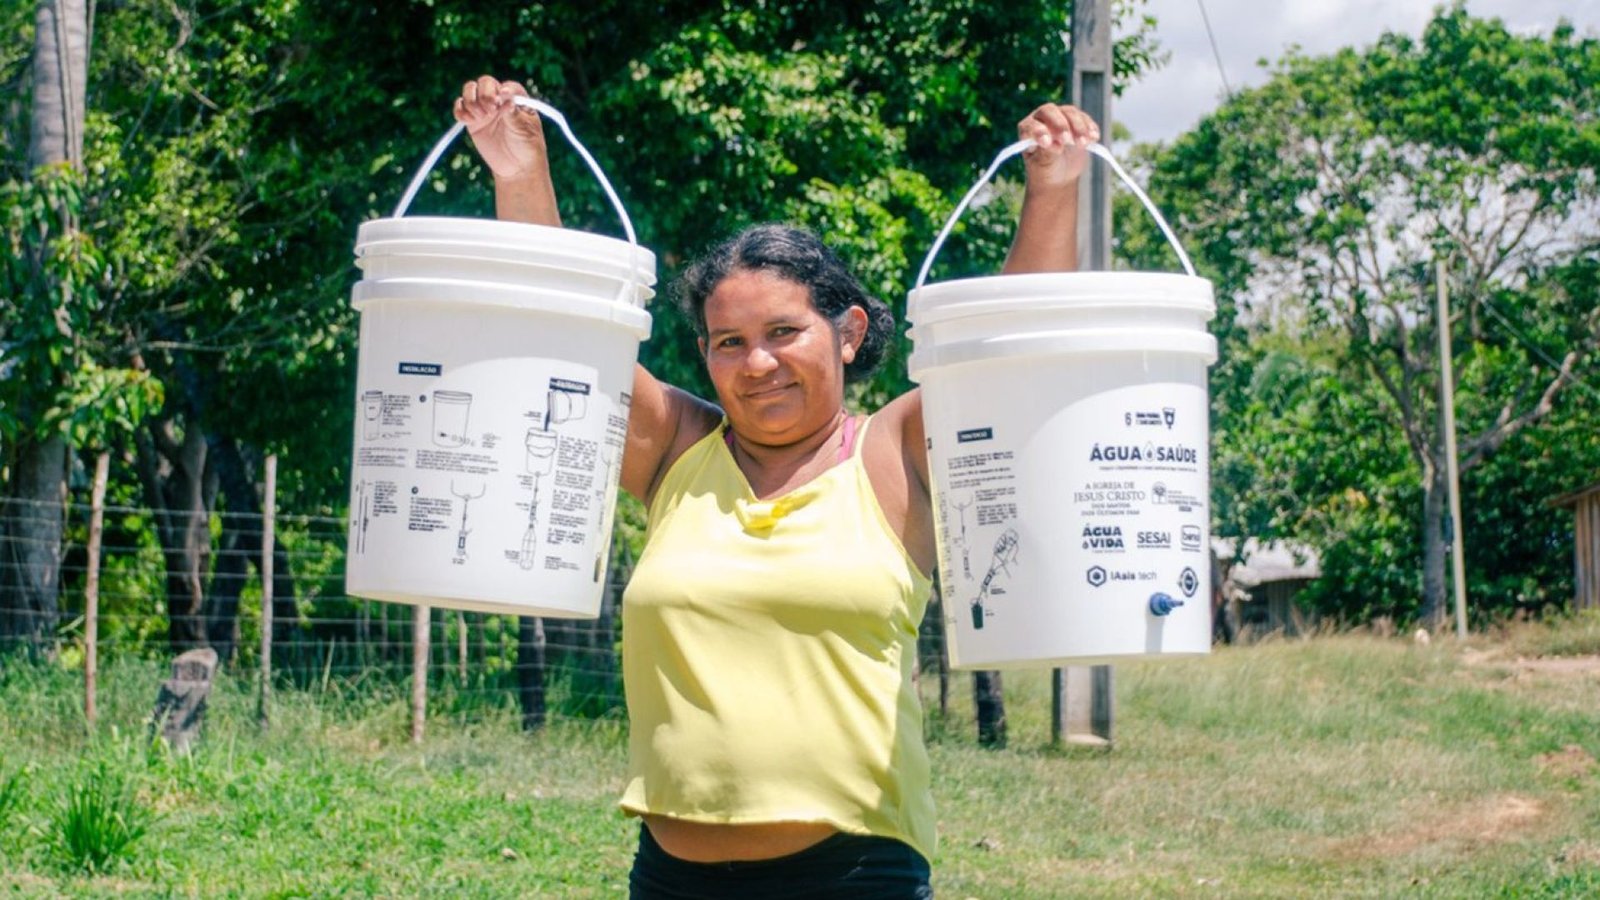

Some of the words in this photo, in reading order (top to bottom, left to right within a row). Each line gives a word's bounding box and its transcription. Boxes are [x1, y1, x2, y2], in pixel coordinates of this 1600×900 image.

[1090, 443, 1142, 461] ÁGUA
[1157, 443, 1197, 464] SAÚDE
[1085, 482, 1092, 490] A
[1093, 482, 1121, 490] IGREJA
[1124, 482, 1135, 490] DE
[1074, 491, 1104, 503] JESUS
[1106, 491, 1146, 502] CRISTO
[1082, 523, 1122, 537] ÁGUA
[1090, 538, 1124, 549] VIDA
[1137, 532, 1172, 544] SESAI
[1138, 571, 1157, 581] tech
